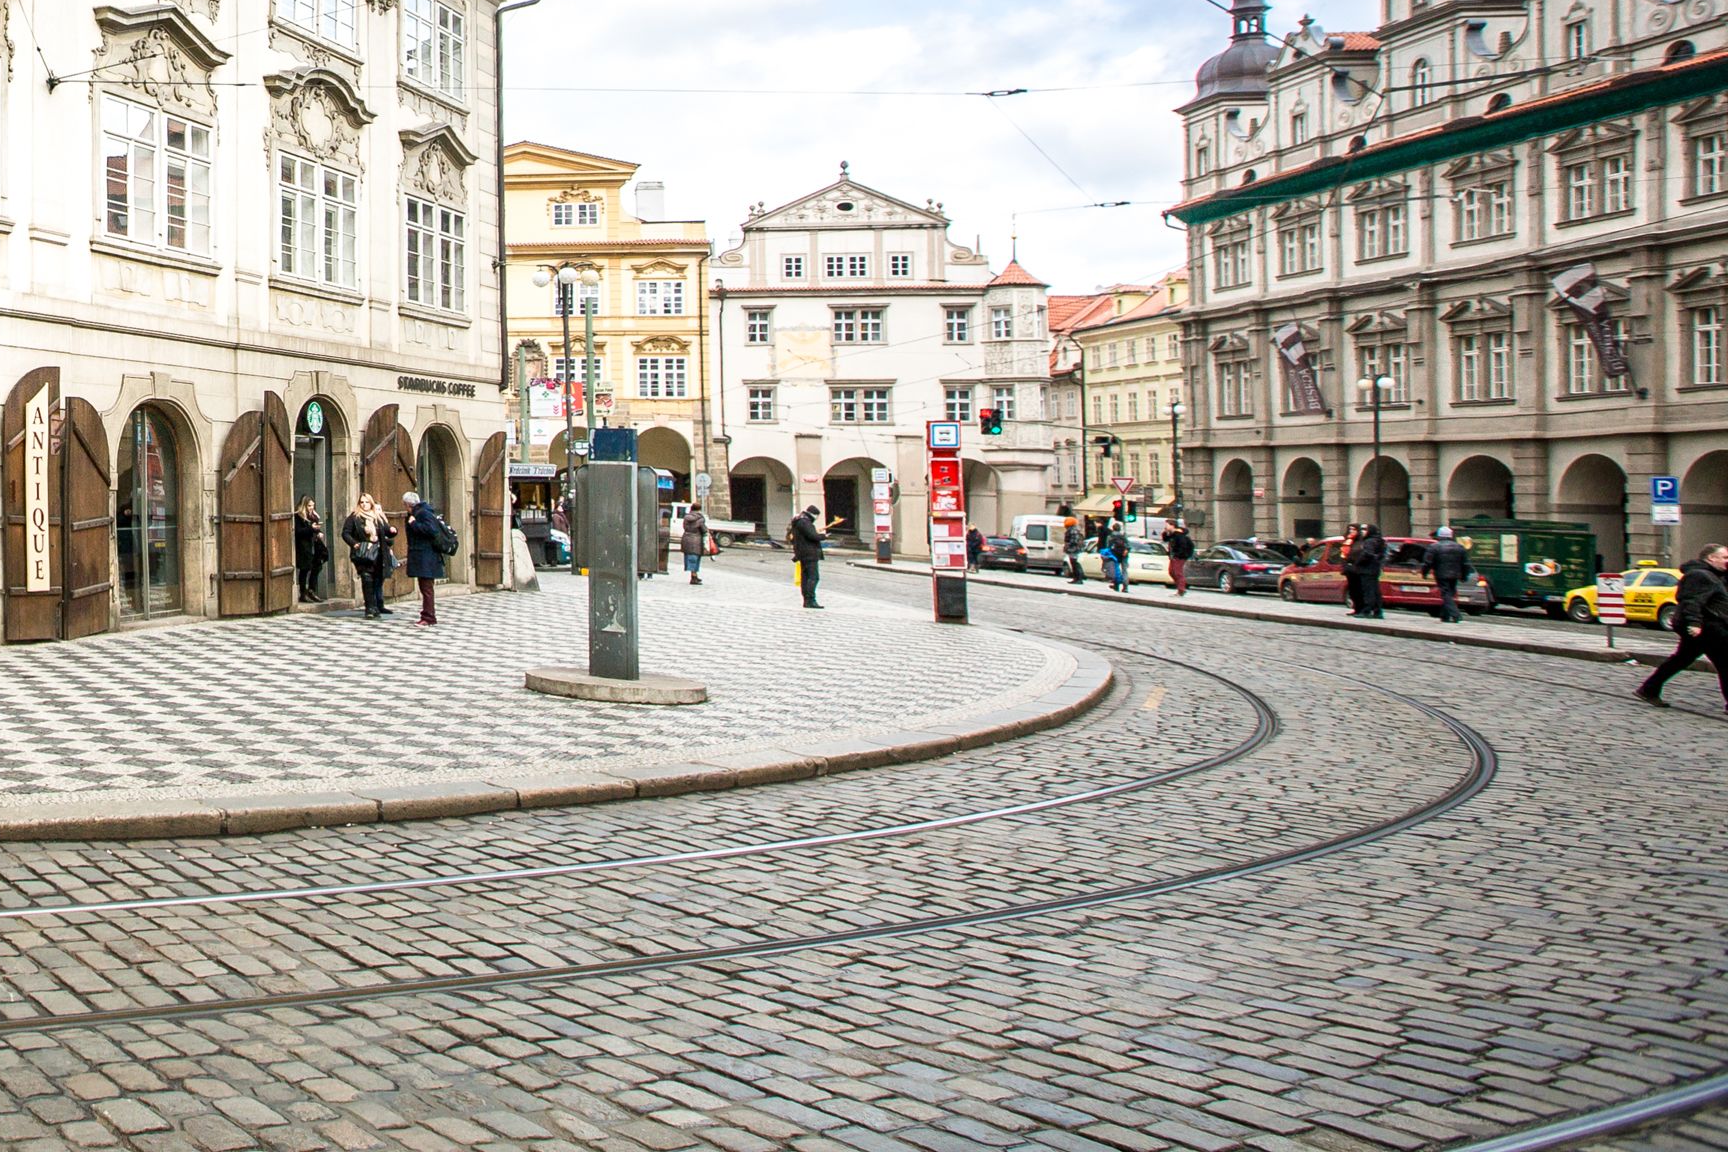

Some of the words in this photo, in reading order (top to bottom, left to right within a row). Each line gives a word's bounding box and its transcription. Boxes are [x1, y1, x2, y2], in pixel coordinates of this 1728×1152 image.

[397, 376, 447, 395] STARBUCKS
[447, 382, 476, 398] COFFEE
[31, 406, 46, 580] ANTIQUE
[1657, 480, 1674, 496] P
